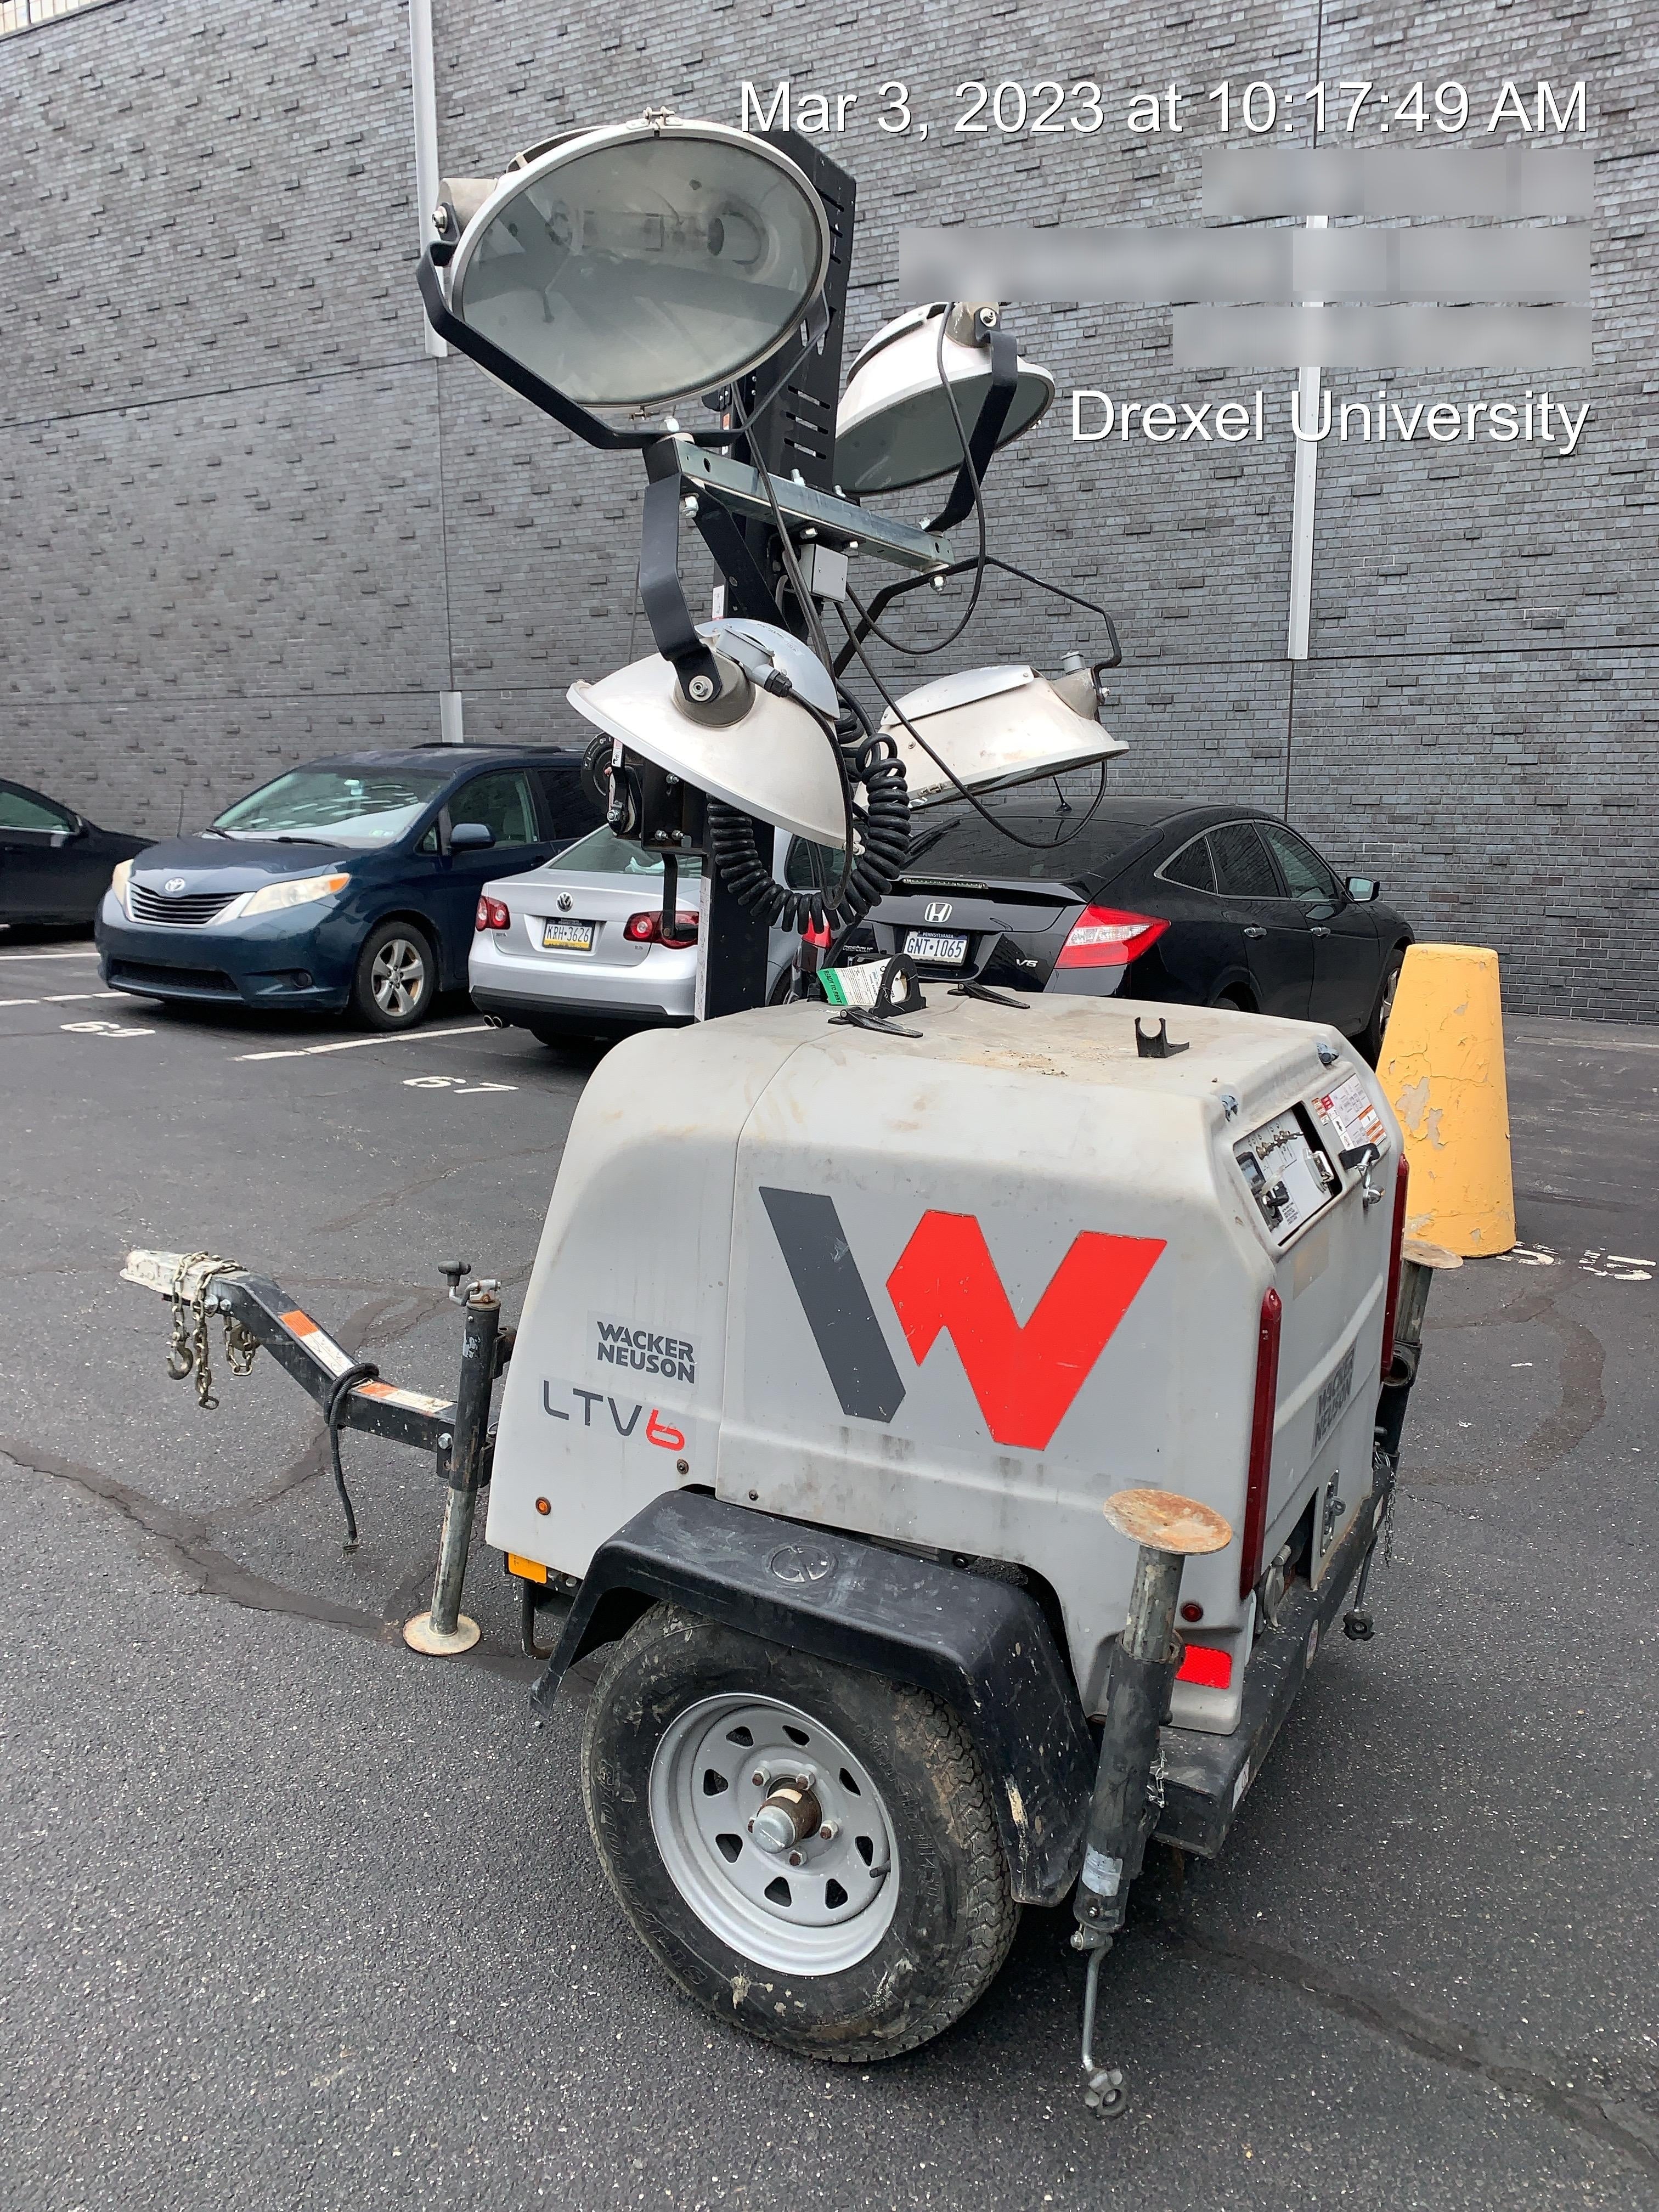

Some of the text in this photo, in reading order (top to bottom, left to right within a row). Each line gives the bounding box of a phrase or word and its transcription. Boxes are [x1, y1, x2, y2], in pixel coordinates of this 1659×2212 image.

[1015, 958, 1039, 968] V6
[823, 970, 834, 984] READY
[833, 991, 843, 1003] RENT
[403, 1076, 520, 1094] 67
[596, 1321, 695, 1363] WACKER
[597, 1342, 695, 1384] NEUSON
[543, 1379, 685, 1451] LTV6
